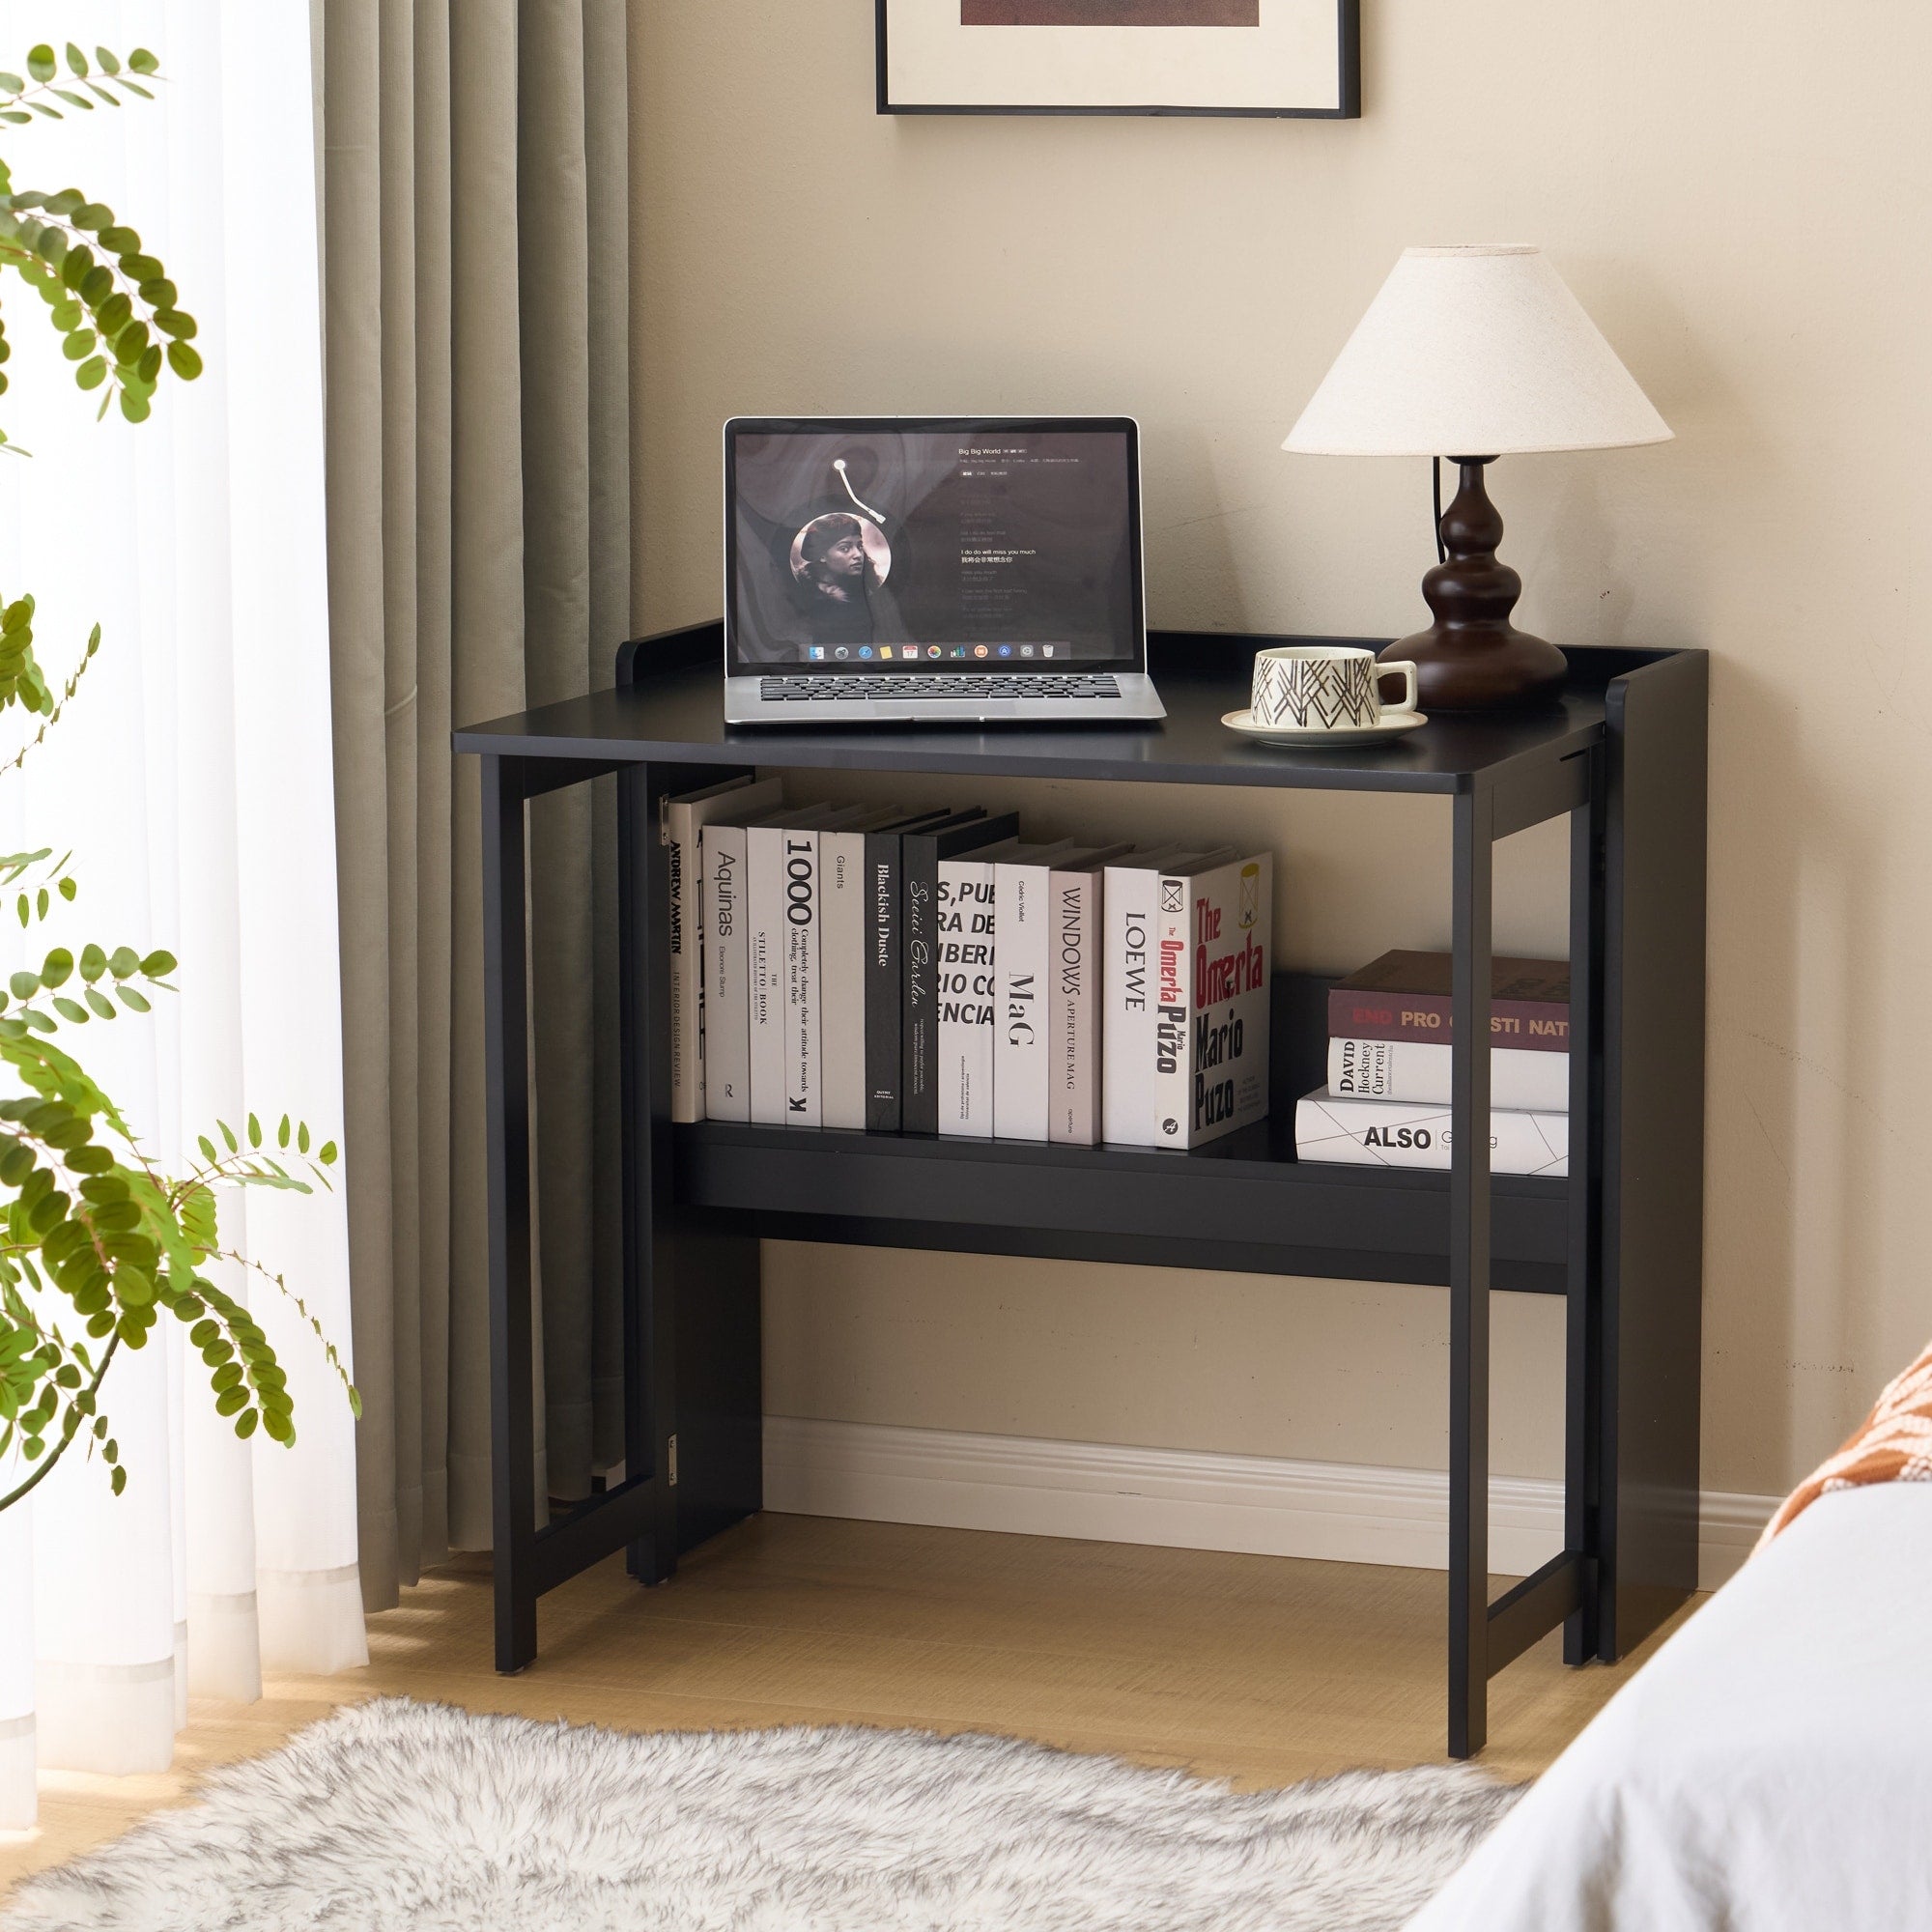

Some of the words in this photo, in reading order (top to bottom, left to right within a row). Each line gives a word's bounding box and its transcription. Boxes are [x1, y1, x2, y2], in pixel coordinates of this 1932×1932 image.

[669, 839, 681, 900] ANDREW
[714, 851, 736, 937] Aquinas
[787, 839, 812, 925] 1000
[837, 855, 845, 889] Giants
[877, 864, 890, 923] Blackish
[670, 902, 682, 954] MARTIN
[789, 927, 799, 962] clothing,
[878, 927, 890, 966] Duste
[971, 914, 994, 935] DE
[1062, 887, 1081, 996] WINDOWS
[1196, 896, 1221, 945] The
[799, 928, 809, 973] Completely
[910, 939, 929, 1009] Garden
[1125, 912, 1146, 1011] LOEWE
[1160, 940, 1184, 1003] Omerta
[1196, 930, 1264, 1009] Omerta
[672, 972, 681, 1011] INTERIOR
[718, 976, 726, 998] Stump
[799, 976, 809, 1005] change
[1009, 971, 1035, 1046] MaG
[1066, 999, 1075, 1061] APERTURE
[1157, 1004, 1186, 1074] Puzo
[1177, 1030, 1186, 1050] Mario
[1195, 1009, 1243, 1074] Mario
[1401, 1010, 1441, 1028] PRO
[1066, 1063, 1075, 1090] MAG
[1340, 1041, 1355, 1093] DAVID
[1358, 1042, 1373, 1094] Hockney
[1372, 1043, 1385, 1094] Current
[1195, 1072, 1235, 1131] Puzo
[1364, 1125, 1432, 1149] ALSO
